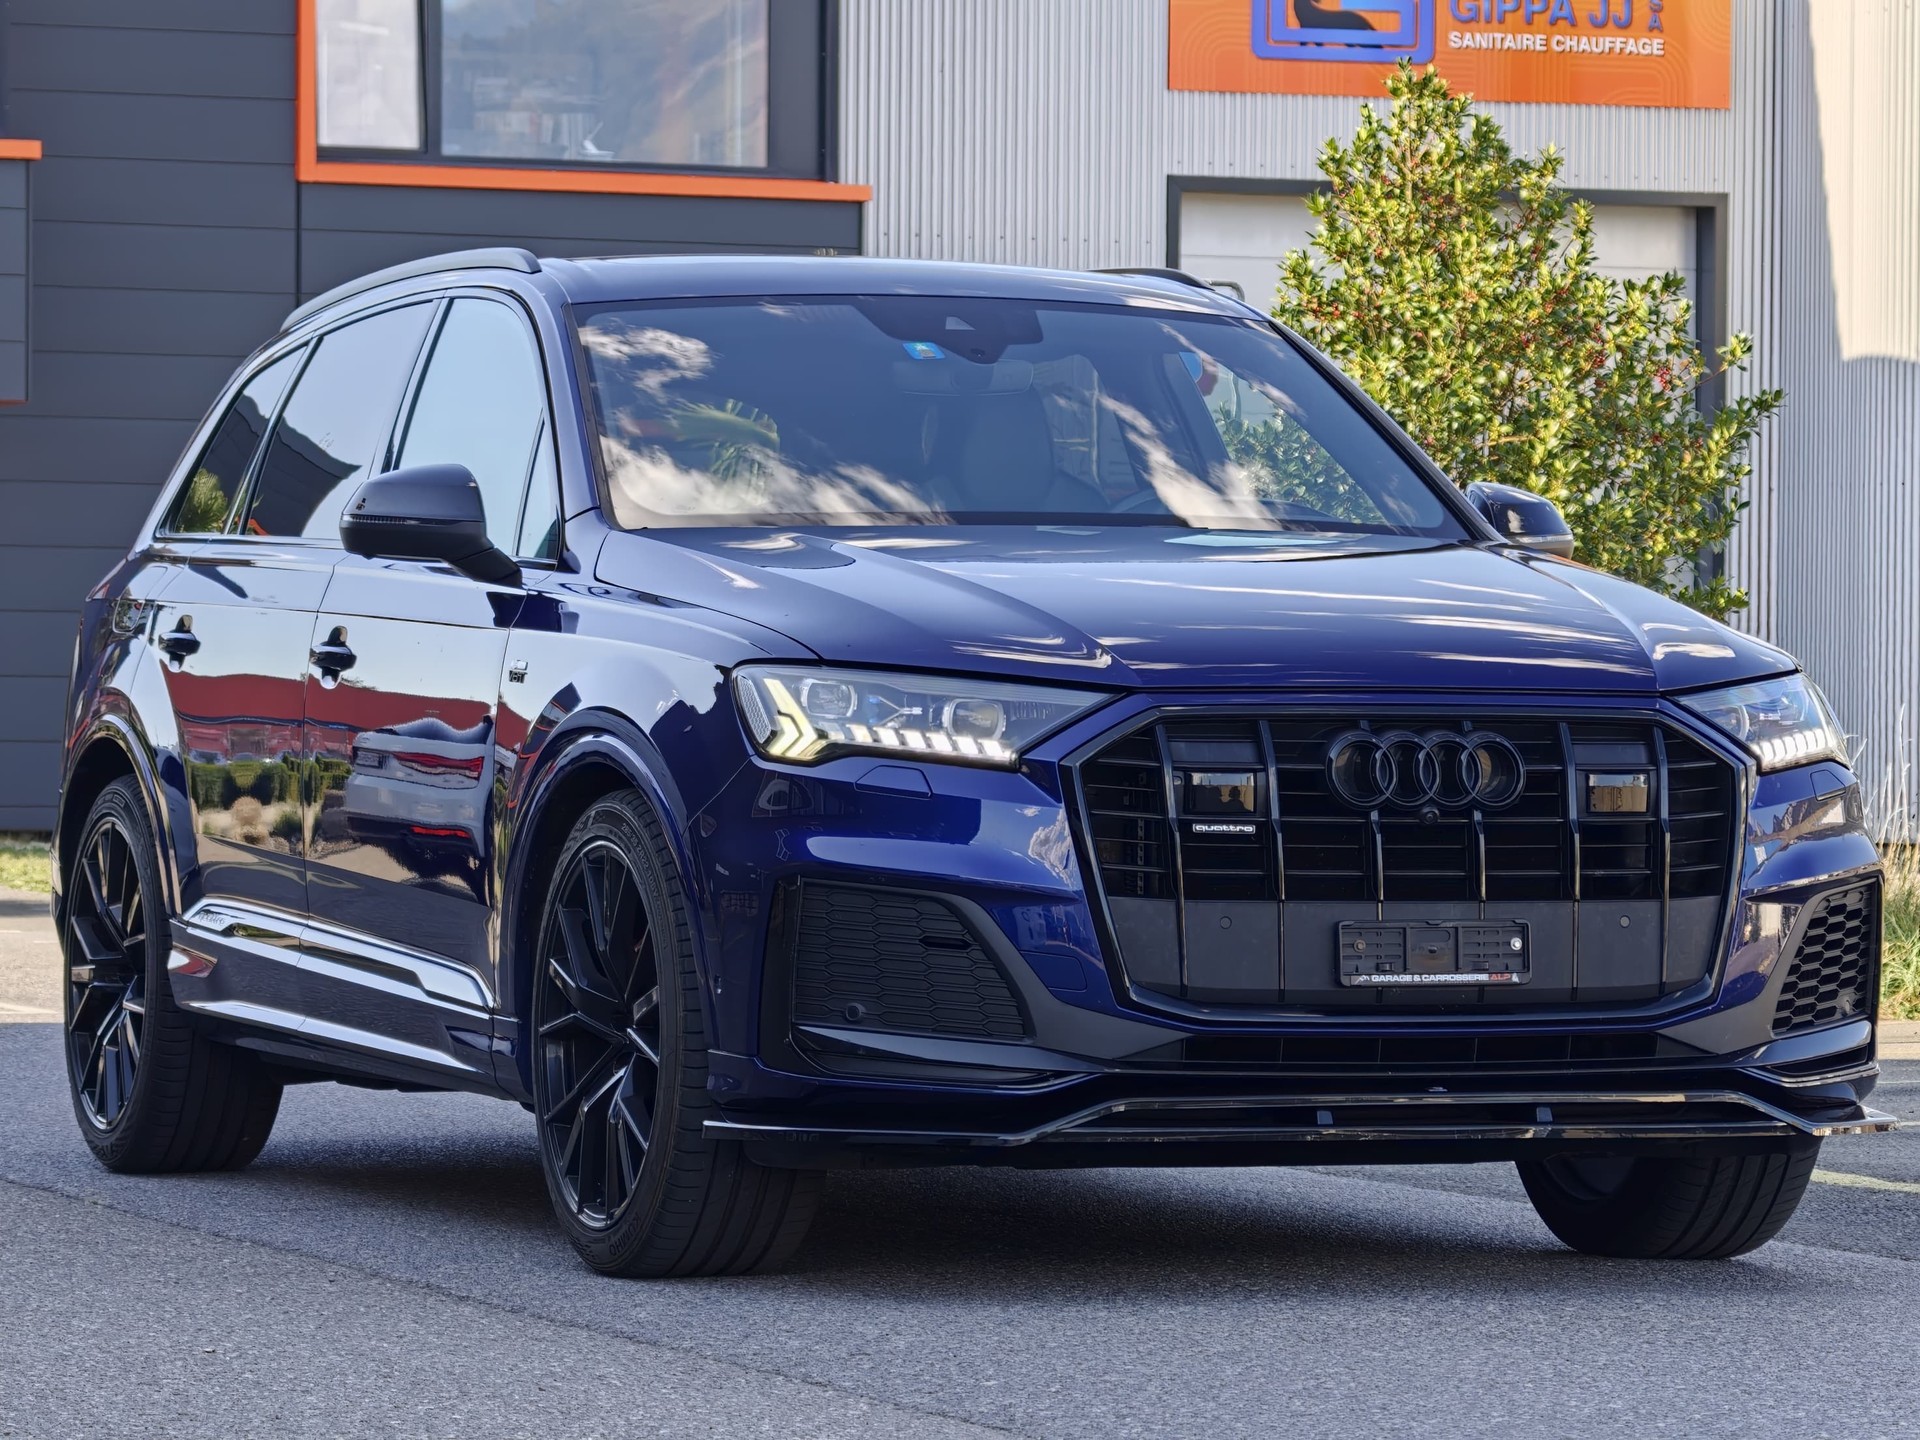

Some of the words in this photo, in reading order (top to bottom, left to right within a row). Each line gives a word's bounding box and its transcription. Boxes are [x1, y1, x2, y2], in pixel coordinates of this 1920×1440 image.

[1450, 0, 1577, 26] GIPPA
[1588, 0, 1632, 29] JJ
[1449, 31, 1548, 51] SANITAIRE
[1551, 35, 1665, 56] CHAUFFAGE
[1195, 825, 1254, 833] quattro
[1371, 974, 1412, 983] GARAGE
[1422, 973, 1489, 982] CARROSSERIE
